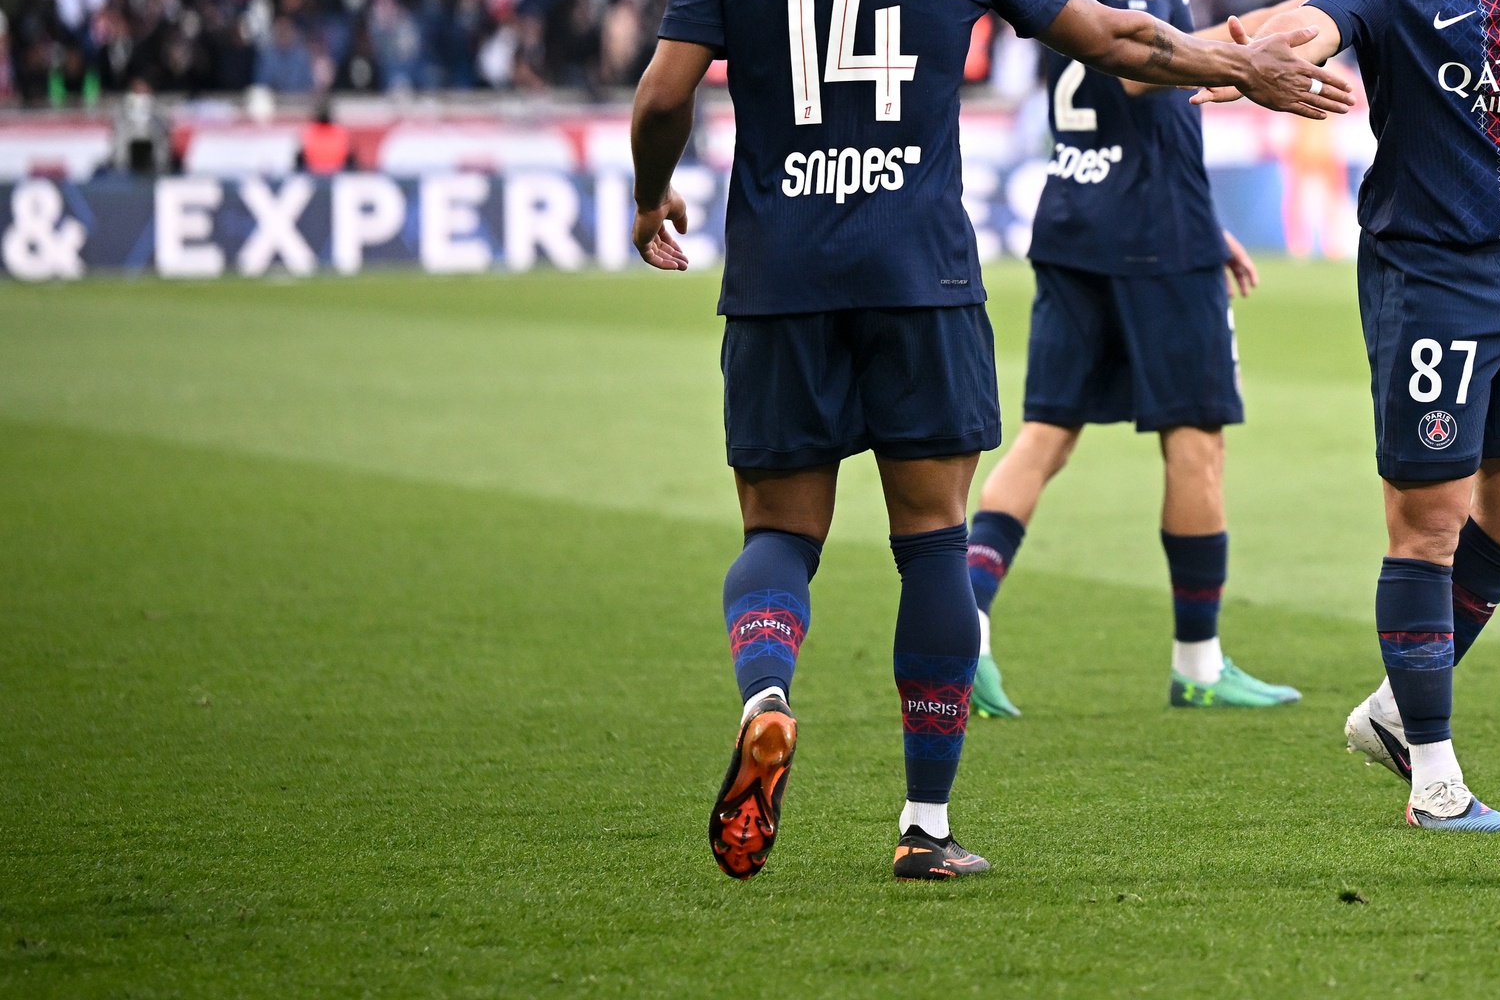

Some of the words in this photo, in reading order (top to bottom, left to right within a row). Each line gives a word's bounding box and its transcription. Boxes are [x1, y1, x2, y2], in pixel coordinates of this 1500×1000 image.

[782, 146, 905, 204] snipes
[2, 178, 86, 281] &
[1409, 338, 1478, 404] 87
[1425, 412, 1451, 422] PARIS
[740, 619, 791, 635] PARIS
[908, 700, 958, 716] PARIS
